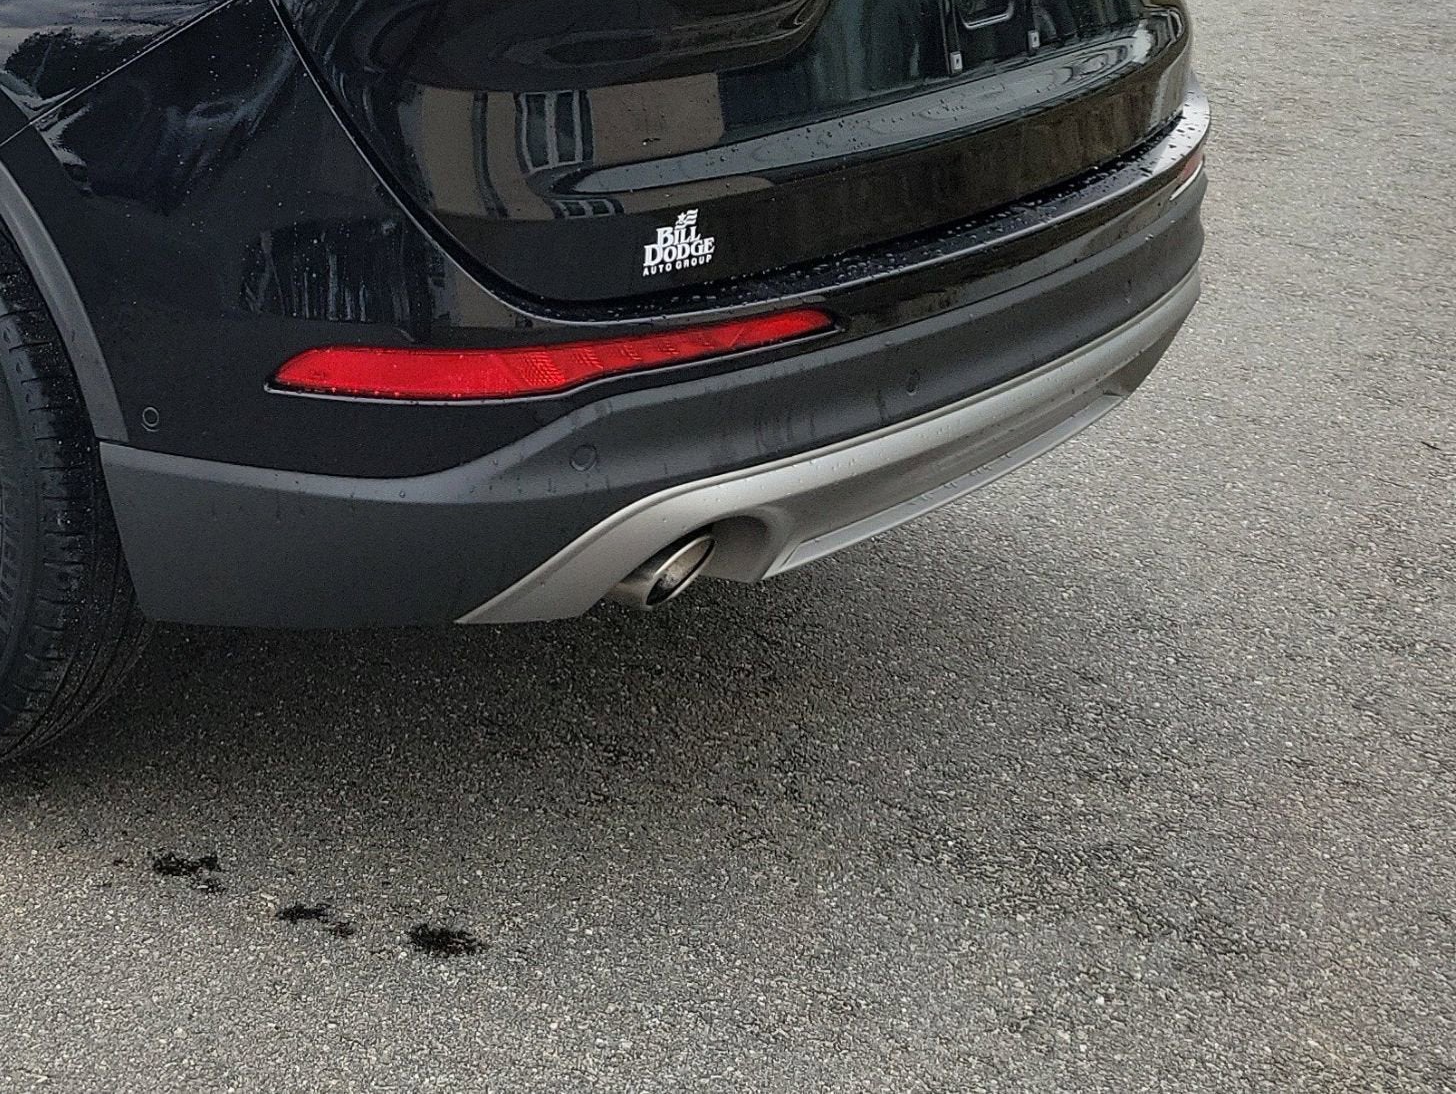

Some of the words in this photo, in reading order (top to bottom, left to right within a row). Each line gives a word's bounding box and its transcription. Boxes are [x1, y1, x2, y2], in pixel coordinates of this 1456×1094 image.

[656, 225, 702, 248] BILL
[642, 237, 715, 267] DODGE
[642, 263, 673, 277] AUTO
[675, 253, 713, 270] GROUP
